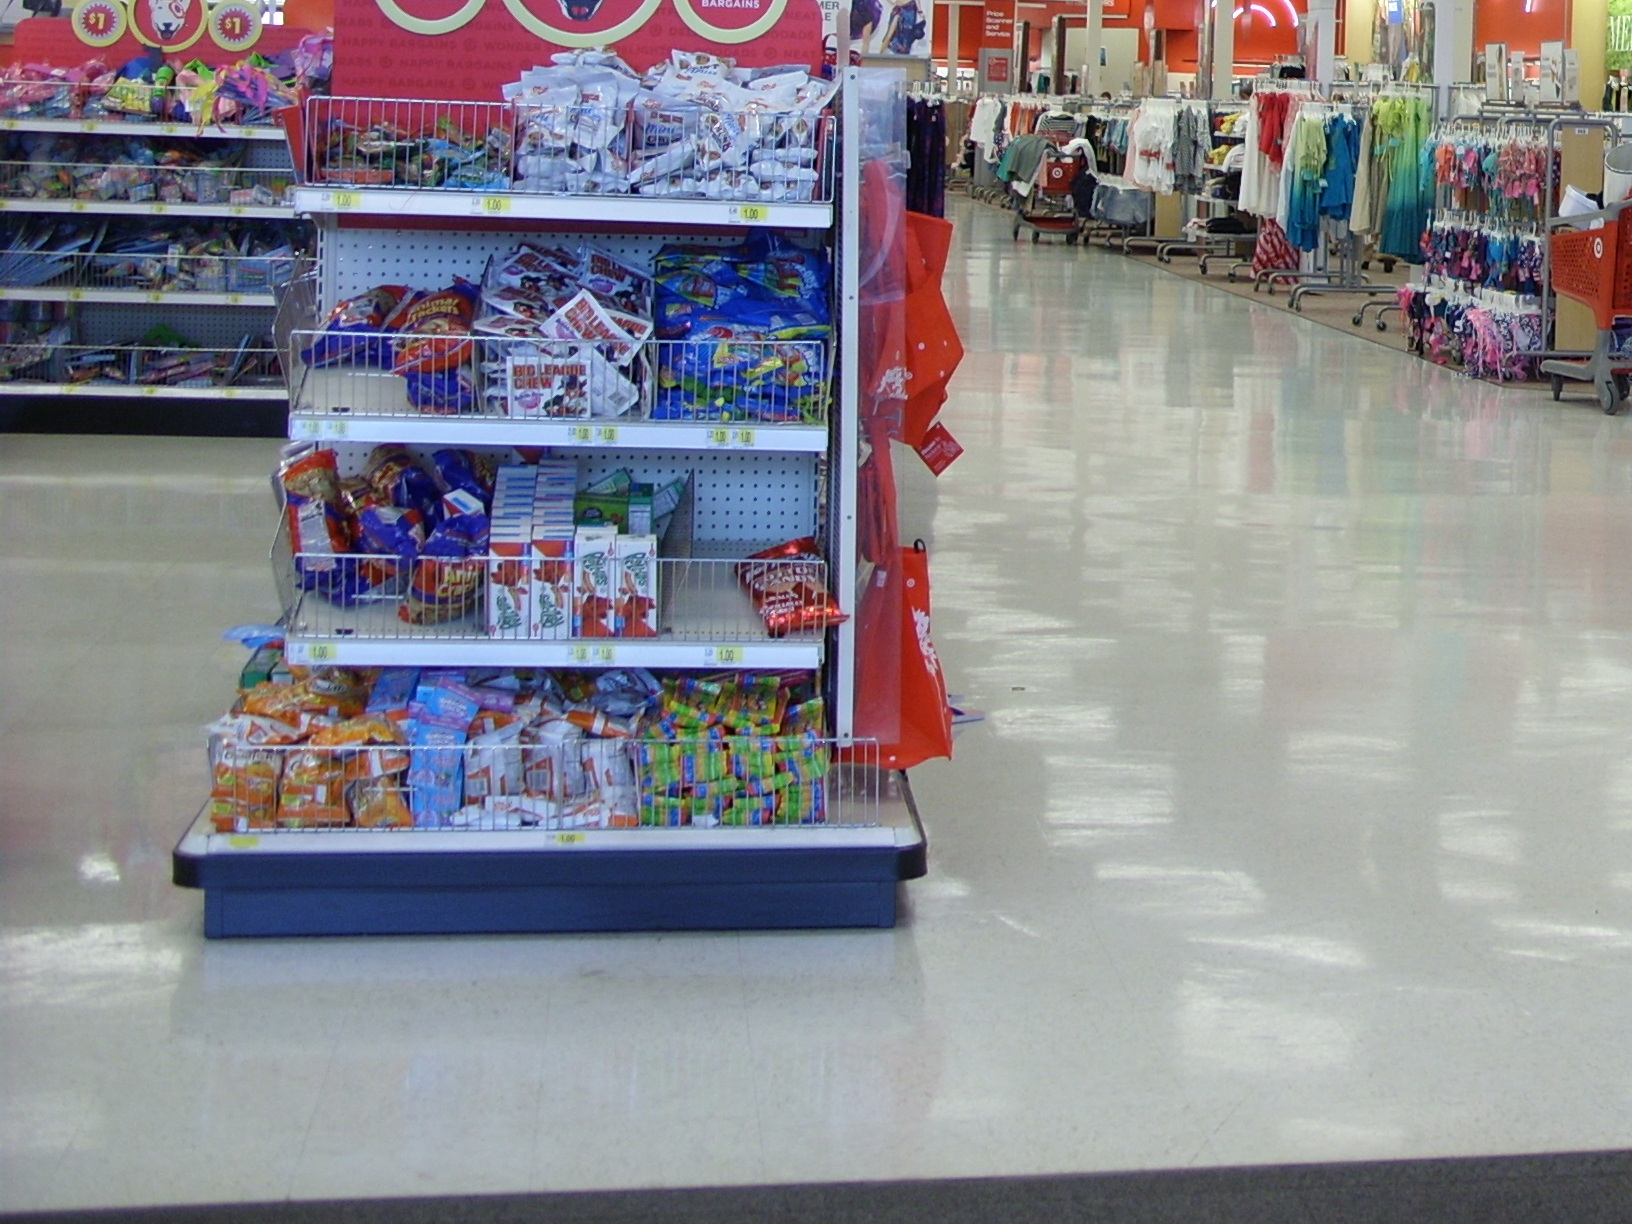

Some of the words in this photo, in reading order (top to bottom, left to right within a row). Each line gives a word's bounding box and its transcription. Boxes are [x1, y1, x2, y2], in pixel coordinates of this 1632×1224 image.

[88, 13, 106, 30] $1
[225, 16, 243, 34] $1
[743, 208, 759, 220] 1.00
